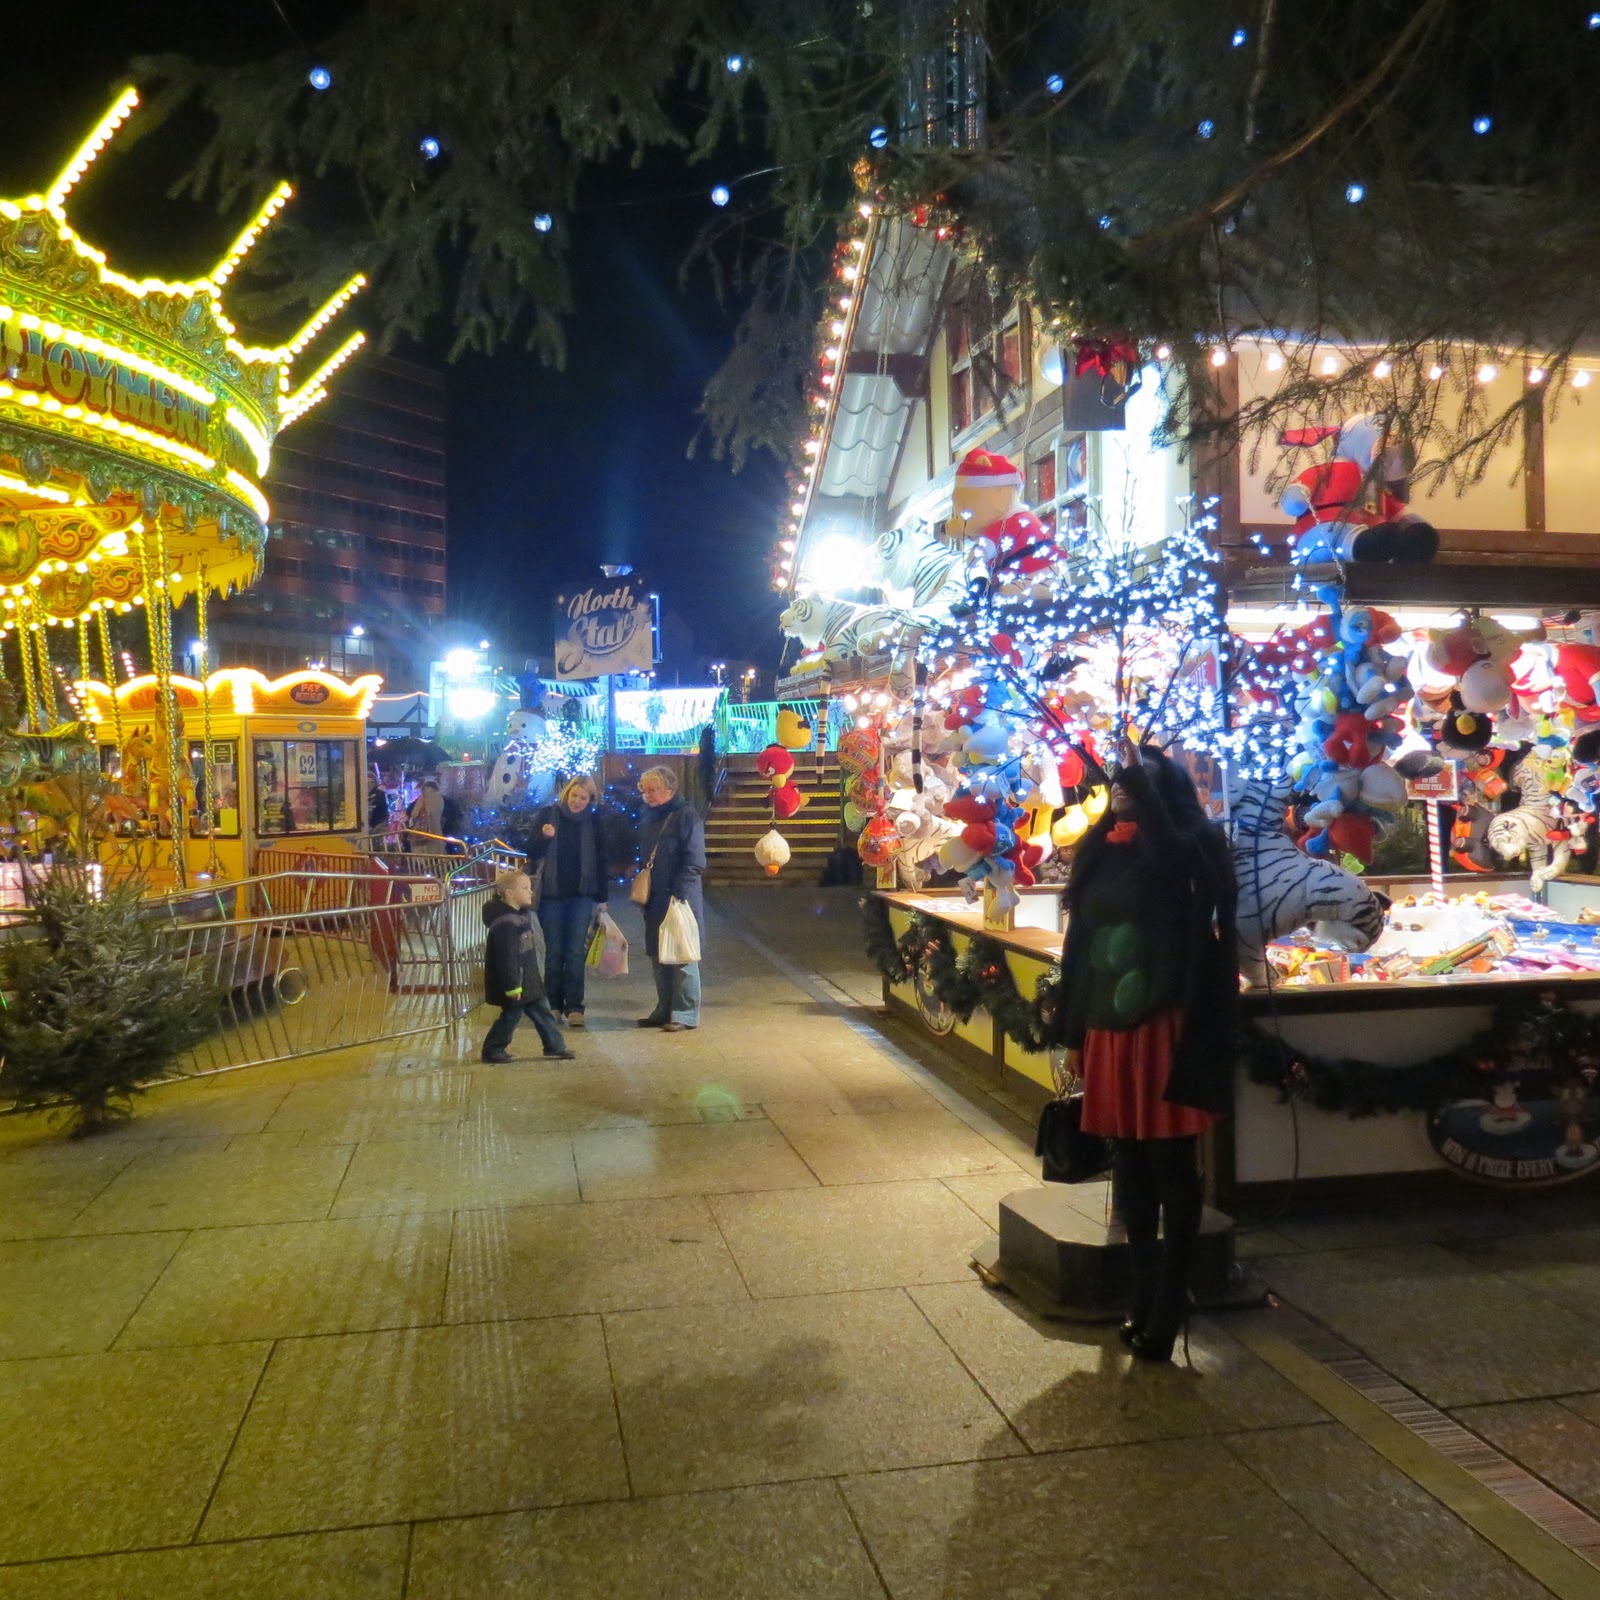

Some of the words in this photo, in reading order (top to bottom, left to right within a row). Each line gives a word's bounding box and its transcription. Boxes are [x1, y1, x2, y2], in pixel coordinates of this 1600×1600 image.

[0, 322, 212, 453] JOYMENT
[567, 586, 636, 619] North
[559, 612, 635, 671] Star
[300, 683, 321, 692] PAY
[299, 755, 315, 775] £2
[424, 885, 439, 893] NO
